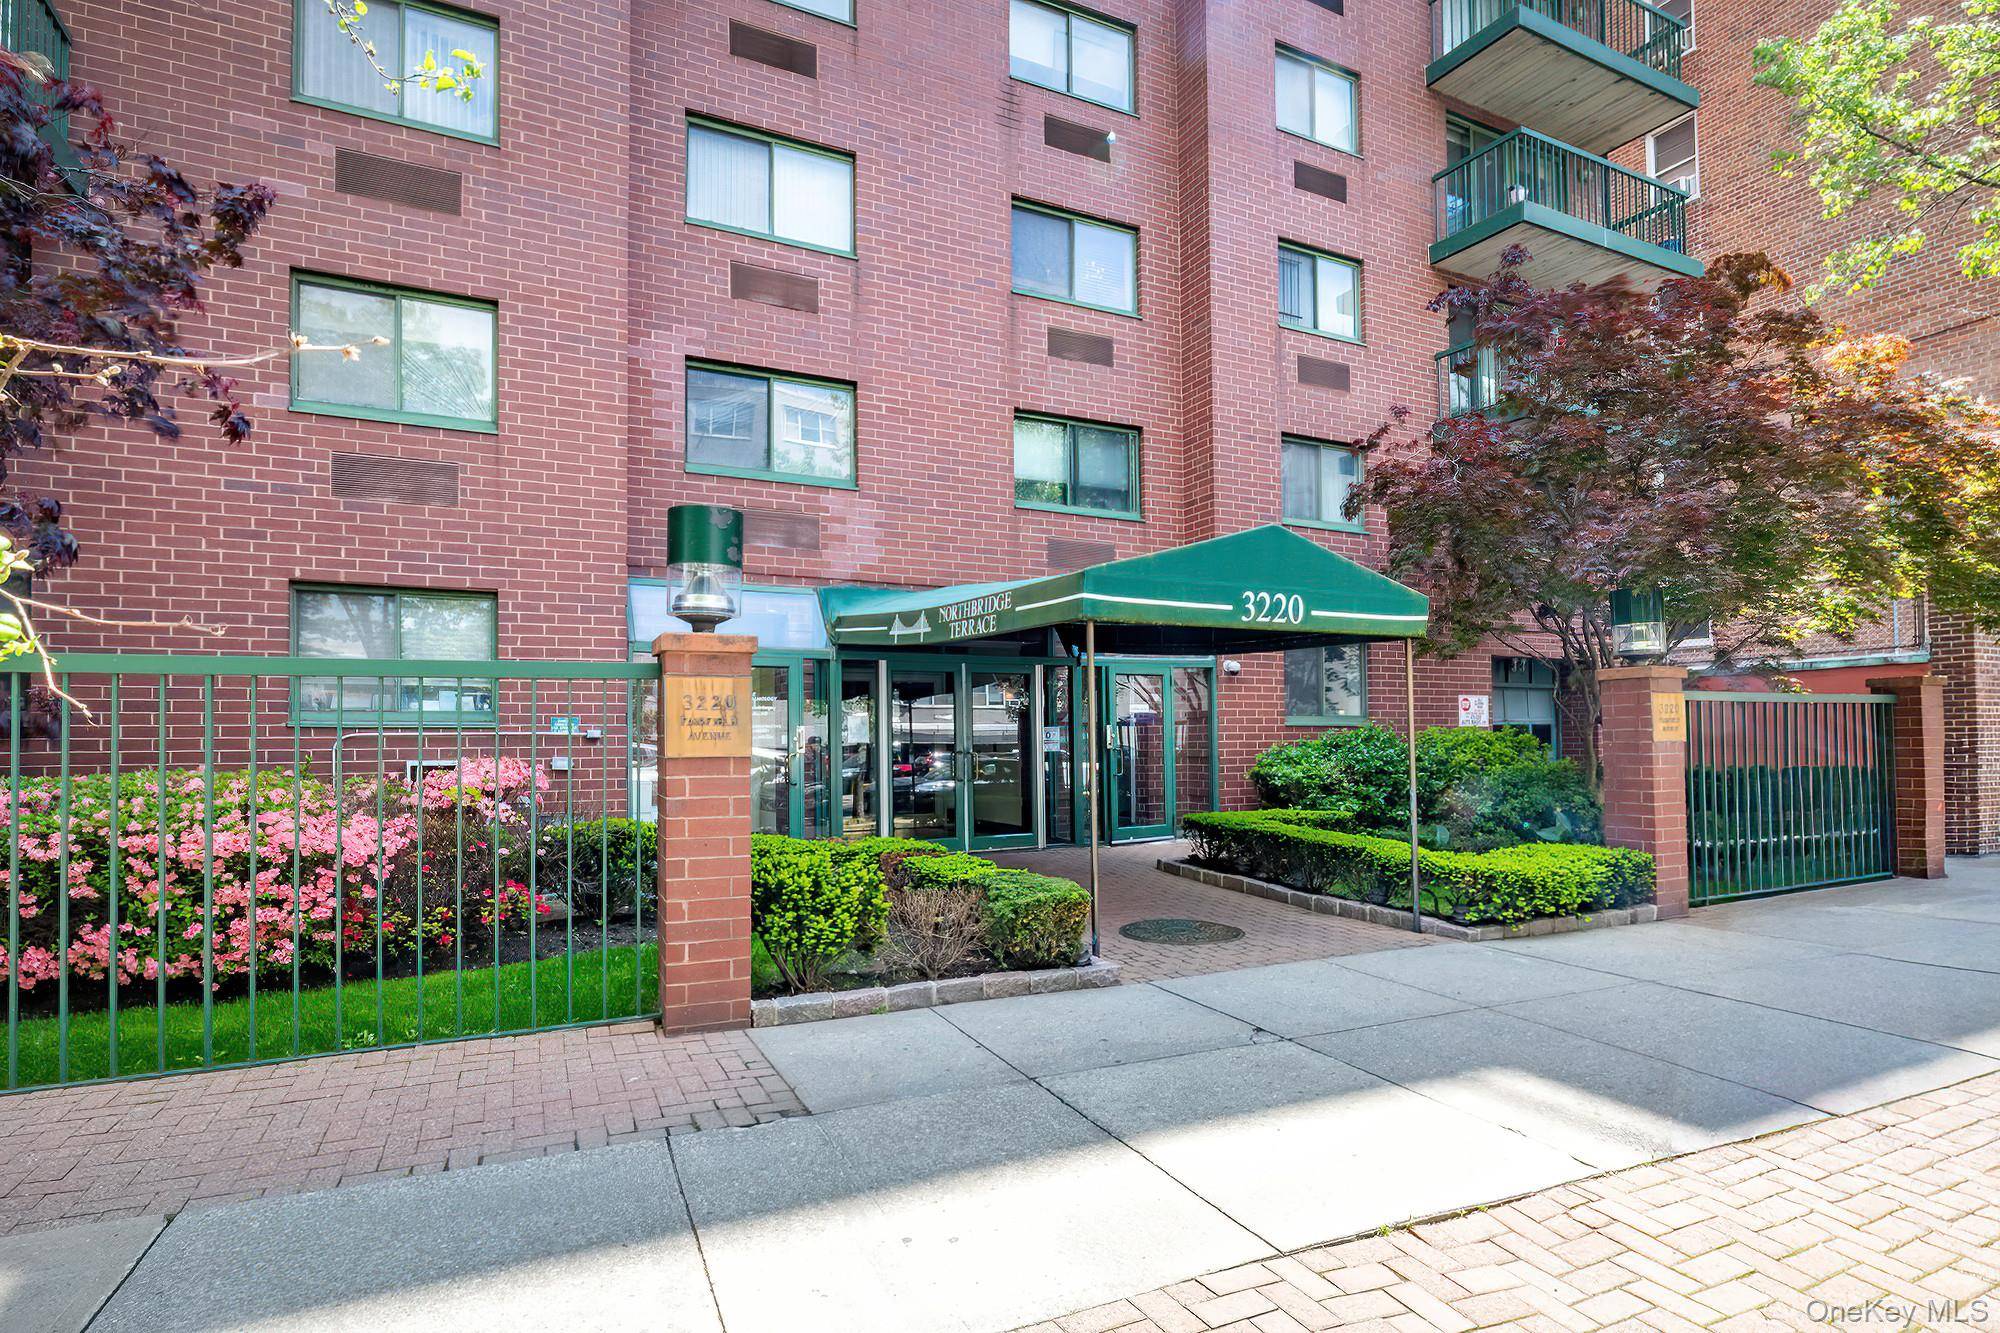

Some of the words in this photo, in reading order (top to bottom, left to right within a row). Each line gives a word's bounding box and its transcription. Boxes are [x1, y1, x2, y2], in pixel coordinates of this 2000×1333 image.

[938, 592, 1012, 623] NORTHBRIDGE
[1241, 591, 1303, 624] 3220
[949, 614, 997, 639] TERRACE
[683, 694, 736, 710] 3220
[688, 731, 731, 741] AVENUE
